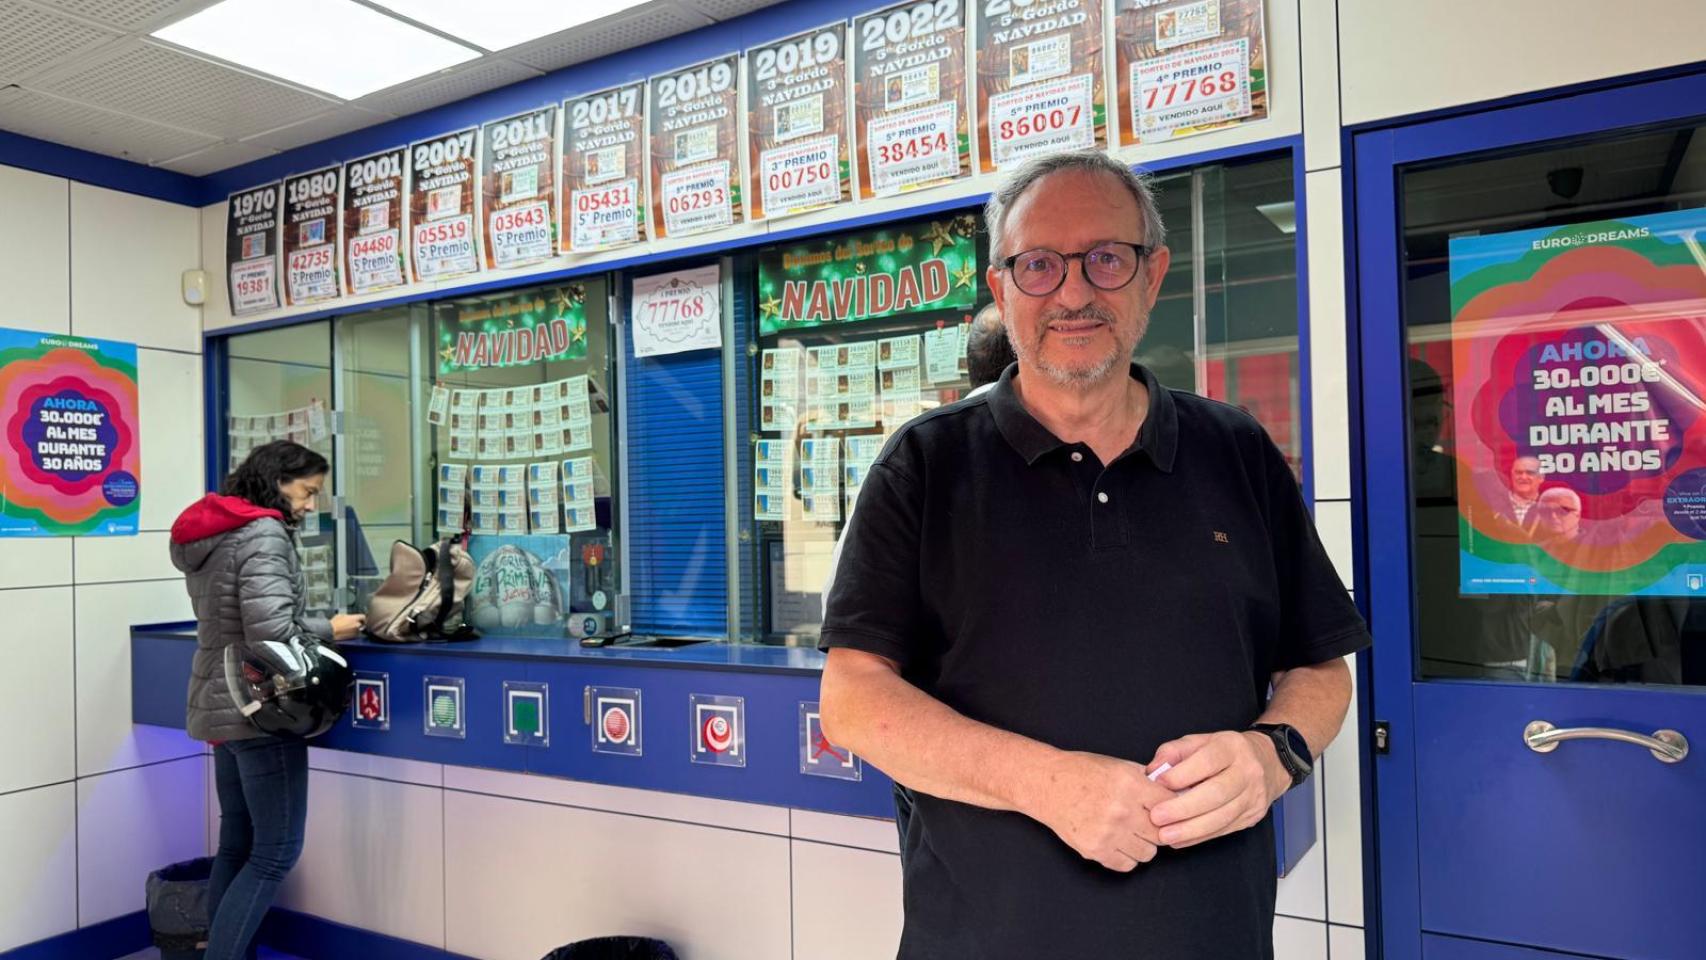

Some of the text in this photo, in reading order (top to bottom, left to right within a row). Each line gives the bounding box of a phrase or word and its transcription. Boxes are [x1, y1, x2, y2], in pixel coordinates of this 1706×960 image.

[1023, 0, 1079, 20] Gordo
[862, 0, 959, 51] 2022
[993, 12, 1086, 44] NAVIDAD
[756, 32, 838, 81] 2019
[896, 36, 945, 56] Gordo
[870, 47, 952, 77] NAVIDAD
[1140, 64, 1170, 75] SORTEO
[1184, 53, 1220, 65] NAVIDAD
[1173, 62, 1222, 80] PREMIO
[658, 63, 731, 108] 2019
[784, 67, 828, 85] Gordo
[762, 78, 834, 107] NAVIDAD
[1143, 72, 1236, 110] 77768
[572, 88, 638, 130] 2017
[683, 94, 722, 113] Gordo
[1025, 96, 1070, 113] PREMIO
[663, 107, 728, 132] NAVIDAD
[1000, 104, 1082, 140] 86007
[1159, 108, 1199, 122] VENDIDO
[492, 113, 548, 151] 2011
[594, 120, 630, 136] Gordo
[899, 122, 936, 138] PREMIO
[414, 132, 474, 171] 2007
[511, 142, 544, 157] Gordo
[576, 131, 635, 152] NAVIDAD
[878, 132, 948, 166] 38454
[1014, 140, 1050, 152] VENDIDO
[494, 152, 547, 172] NAVIDAD
[784, 150, 827, 168] PREMIO
[350, 153, 402, 188] 2001
[769, 162, 831, 192] 00750
[891, 166, 920, 176] VENDIDO
[288, 172, 336, 204] 1980
[419, 172, 470, 192] NAVIDAD
[686, 179, 715, 192] PREMIO
[234, 189, 276, 218] 1970
[353, 189, 398, 208] NAVIDAD
[578, 188, 632, 212] 05431
[670, 188, 724, 214] 06293
[292, 206, 334, 222] NAVIDAD
[494, 208, 544, 232] 03643
[593, 206, 633, 223] Premio
[237, 220, 275, 236] NAVIDAD
[418, 222, 466, 244] 05519
[506, 226, 546, 244] Premio
[354, 236, 394, 257] 04480
[430, 239, 470, 258] Premio
[1532, 228, 1650, 250] EURO DREAMS
[292, 250, 329, 271] 42735
[362, 253, 394, 268] Premio
[300, 267, 331, 281] Premio
[236, 277, 269, 296] 19381
[780, 258, 950, 322] NAVIDAD
[648, 295, 704, 322] 77768
[40, 338, 98, 350] EURO DREAMS
[454, 319, 570, 366] NAVIDAD
[1539, 336, 1652, 364] AHORA
[43, 397, 98, 411] AHORA
[1546, 391, 1650, 417] AL MES
[46, 426, 97, 441] AL MES
[1530, 419, 1670, 446] DURANTE
[38, 441, 106, 456] DURANTE
[42, 455, 102, 471] 30 AÑOS
[1538, 446, 1662, 474] 30 AÑOS
